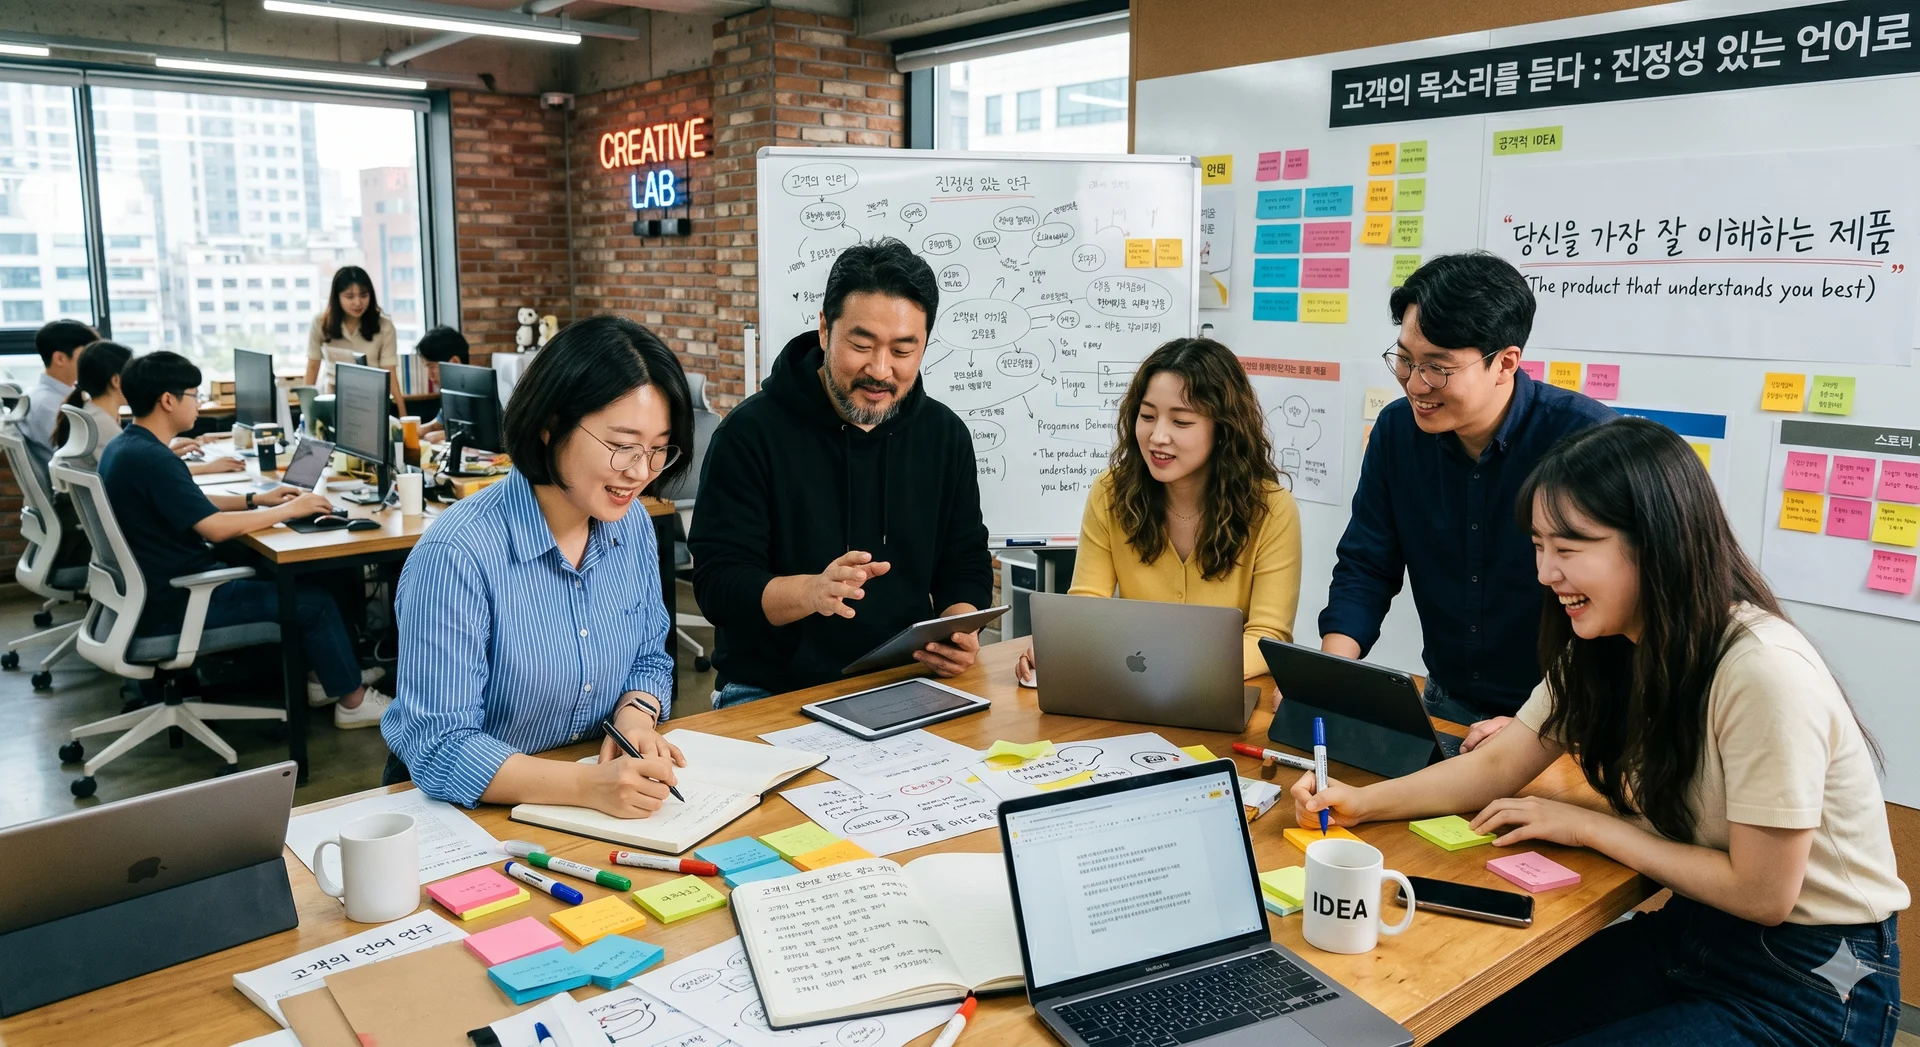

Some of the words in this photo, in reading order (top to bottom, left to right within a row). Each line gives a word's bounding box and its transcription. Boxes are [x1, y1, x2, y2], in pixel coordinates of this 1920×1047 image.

[1342, 74, 1411, 110] 고객의
[1417, 61, 1520, 104] 목소리를
[1528, 52, 1585, 93] 듣다
[1611, 37, 1705, 83] 진정성
[1716, 30, 1786, 73] 있는
[1797, 12, 1912, 63] 언어로
[600, 117, 706, 169] CREATIVE
[1532, 134, 1556, 146] IDEA
[630, 169, 676, 209] LAB
[935, 175, 974, 193] 진정성
[980, 176, 1001, 192] 있는
[1591, 218, 1646, 256] 가장
[1657, 216, 1687, 257] 잘
[1699, 215, 1815, 252] 이해하는
[1561, 275, 1621, 298] product
[1626, 275, 1663, 296] that
[1667, 277, 1773, 298] understands
[1780, 283, 1814, 304] you
[1821, 274, 1876, 303] best)
[1057, 447, 1087, 462] product
[1874, 433, 1913, 449] 스토리
[1039, 463, 1087, 476] understands
[1041, 483, 1056, 496] you
[1313, 891, 1368, 920] IDEA
[290, 953, 351, 981] 고객의
[355, 938, 396, 956] 언어
